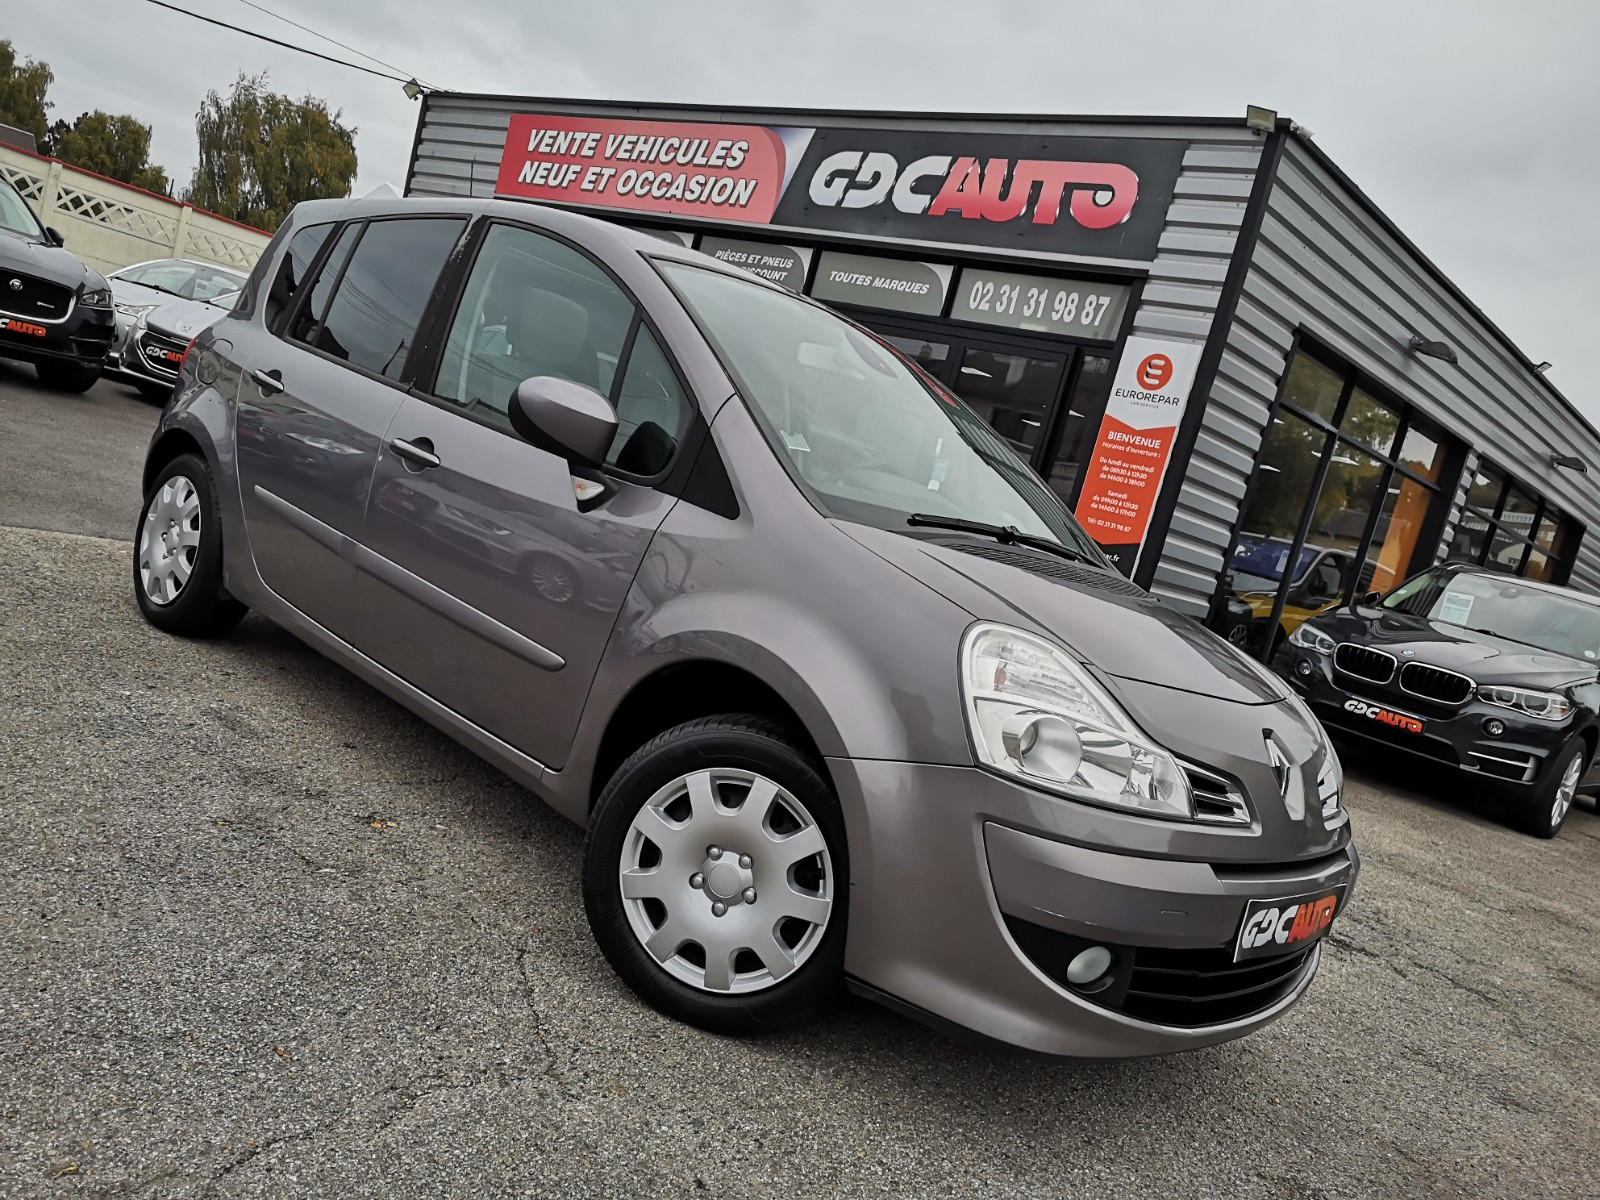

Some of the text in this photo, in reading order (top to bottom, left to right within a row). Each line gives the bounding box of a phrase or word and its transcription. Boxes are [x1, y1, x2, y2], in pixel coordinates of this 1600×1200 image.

[526, 129, 750, 169] VENTE VEHICULES
[517, 161, 758, 207] NEUF ET OCCASION
[715, 249, 794, 269] PIÈCES ET PNEUS
[742, 267, 788, 281] COUNT
[829, 270, 930, 295] TOUTES MARQUES
[968, 280, 1111, 326] 02 31 31 98 87
[1115, 388, 1180, 407] EUROREPAR
[1107, 431, 1162, 449] BIENVENUE
[1102, 442, 1125, 451] Horaires
[1126, 446, 1158, 458] d'ouverture
[1108, 458, 1122, 466] lundi
[1130, 464, 1155, 473] vendredi
[1107, 490, 1128, 500] Samedi
